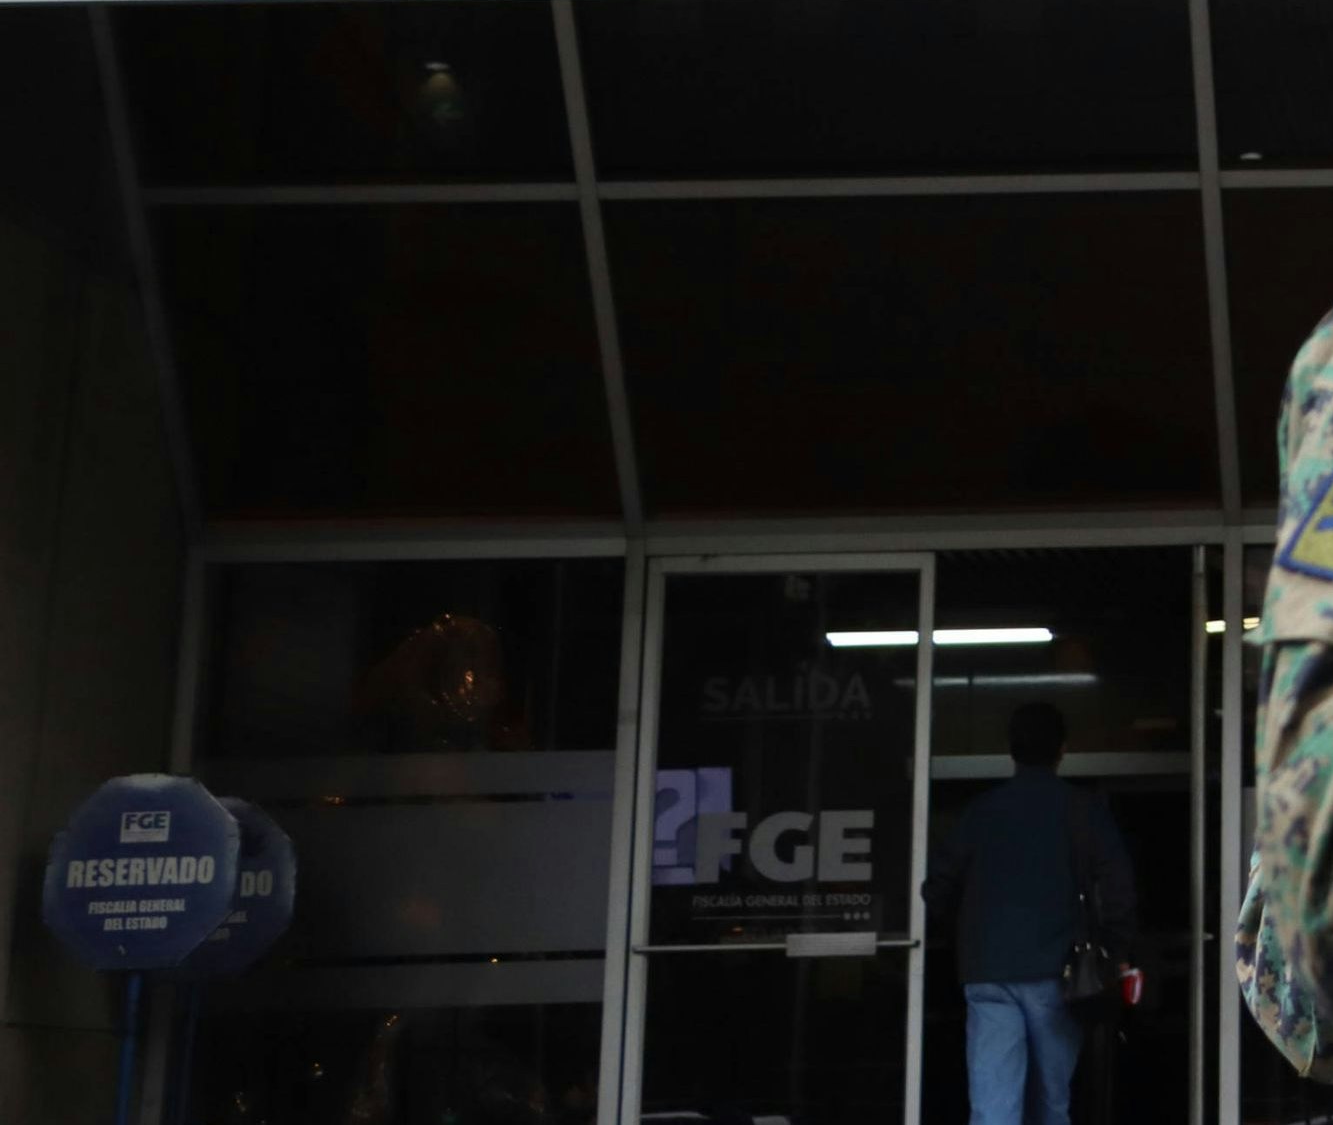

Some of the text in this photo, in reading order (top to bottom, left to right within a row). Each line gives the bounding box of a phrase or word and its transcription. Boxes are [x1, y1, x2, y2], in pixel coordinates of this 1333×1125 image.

[124, 813, 167, 830] FGE
[694, 810, 874, 884] FGE
[67, 855, 216, 888] RESERVADO
[138, 898, 186, 913] GENERAL
[745, 893, 799, 907] GENERAL
[802, 893, 822, 907] DEL
[825, 893, 873, 906] ESTADO
[103, 915, 168, 931] DEL ESTADO
